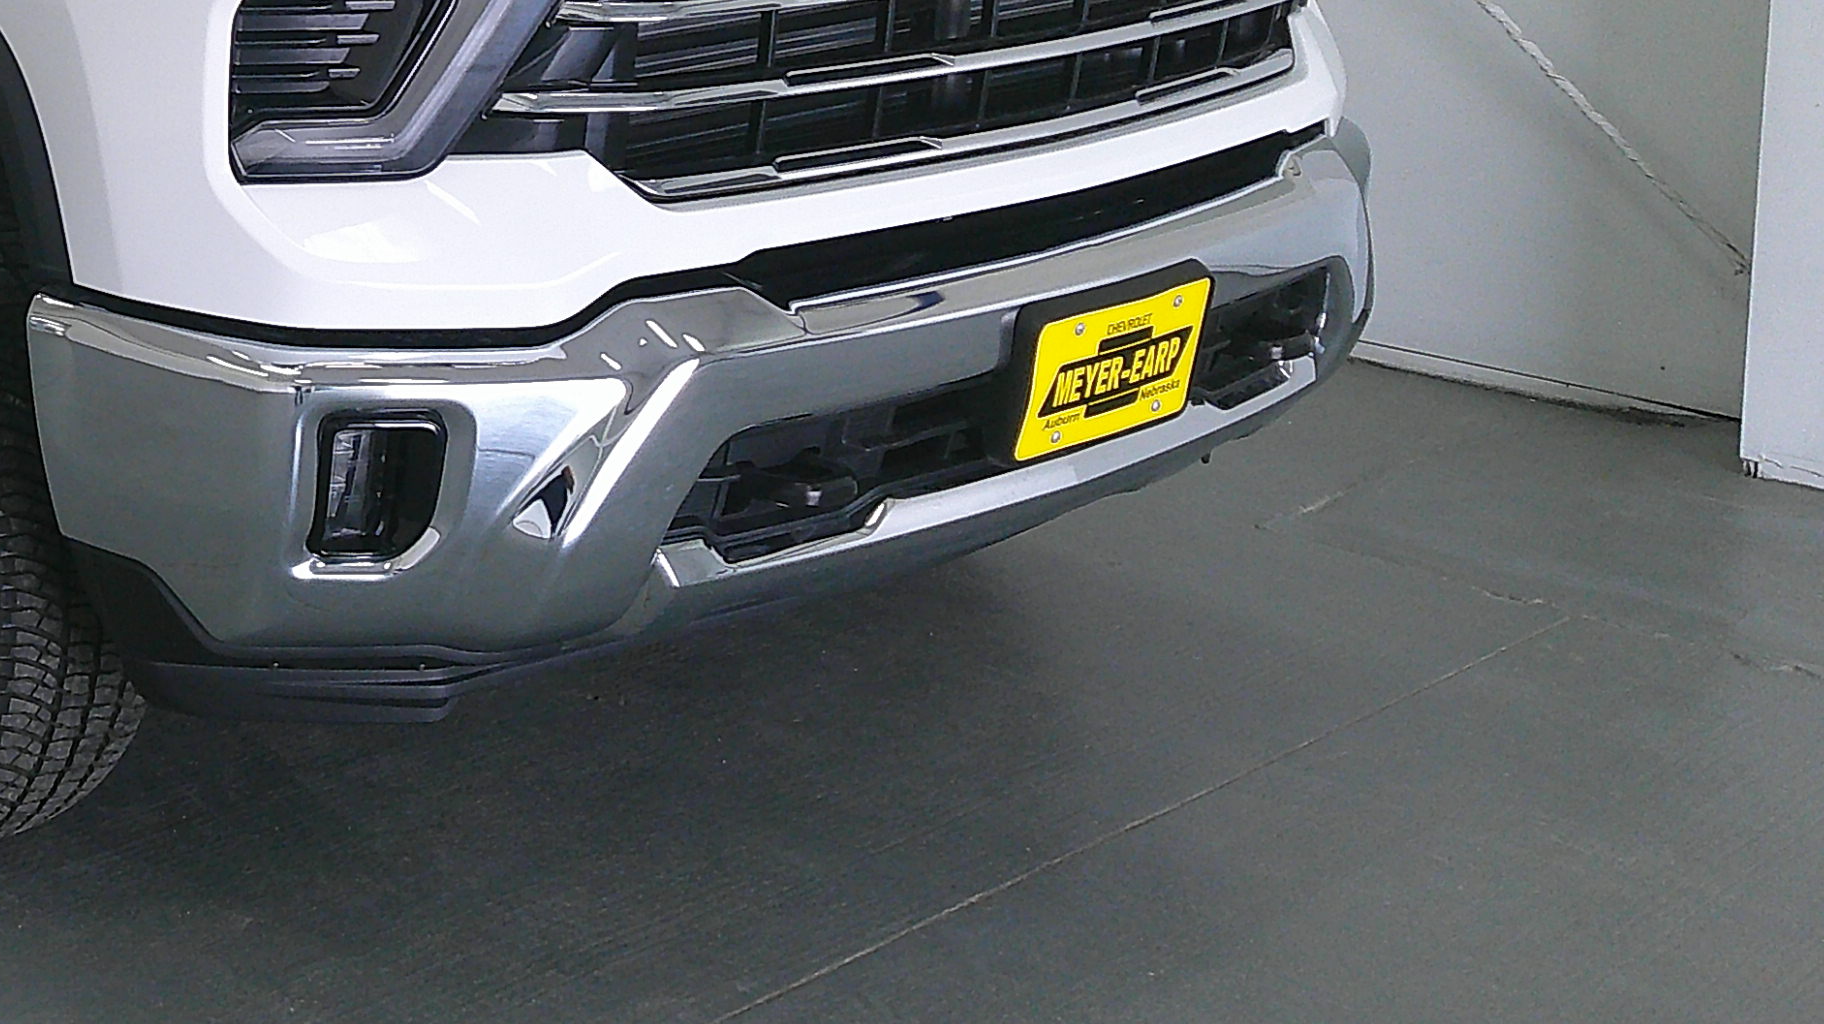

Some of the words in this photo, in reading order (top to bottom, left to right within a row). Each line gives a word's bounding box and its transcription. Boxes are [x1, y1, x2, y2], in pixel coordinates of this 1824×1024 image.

[1107, 313, 1152, 335] CHEVROLET
[1052, 337, 1181, 407] MEYER-EARP
[1140, 380, 1180, 400] Nebraska
[1043, 414, 1081, 430] Auburn
